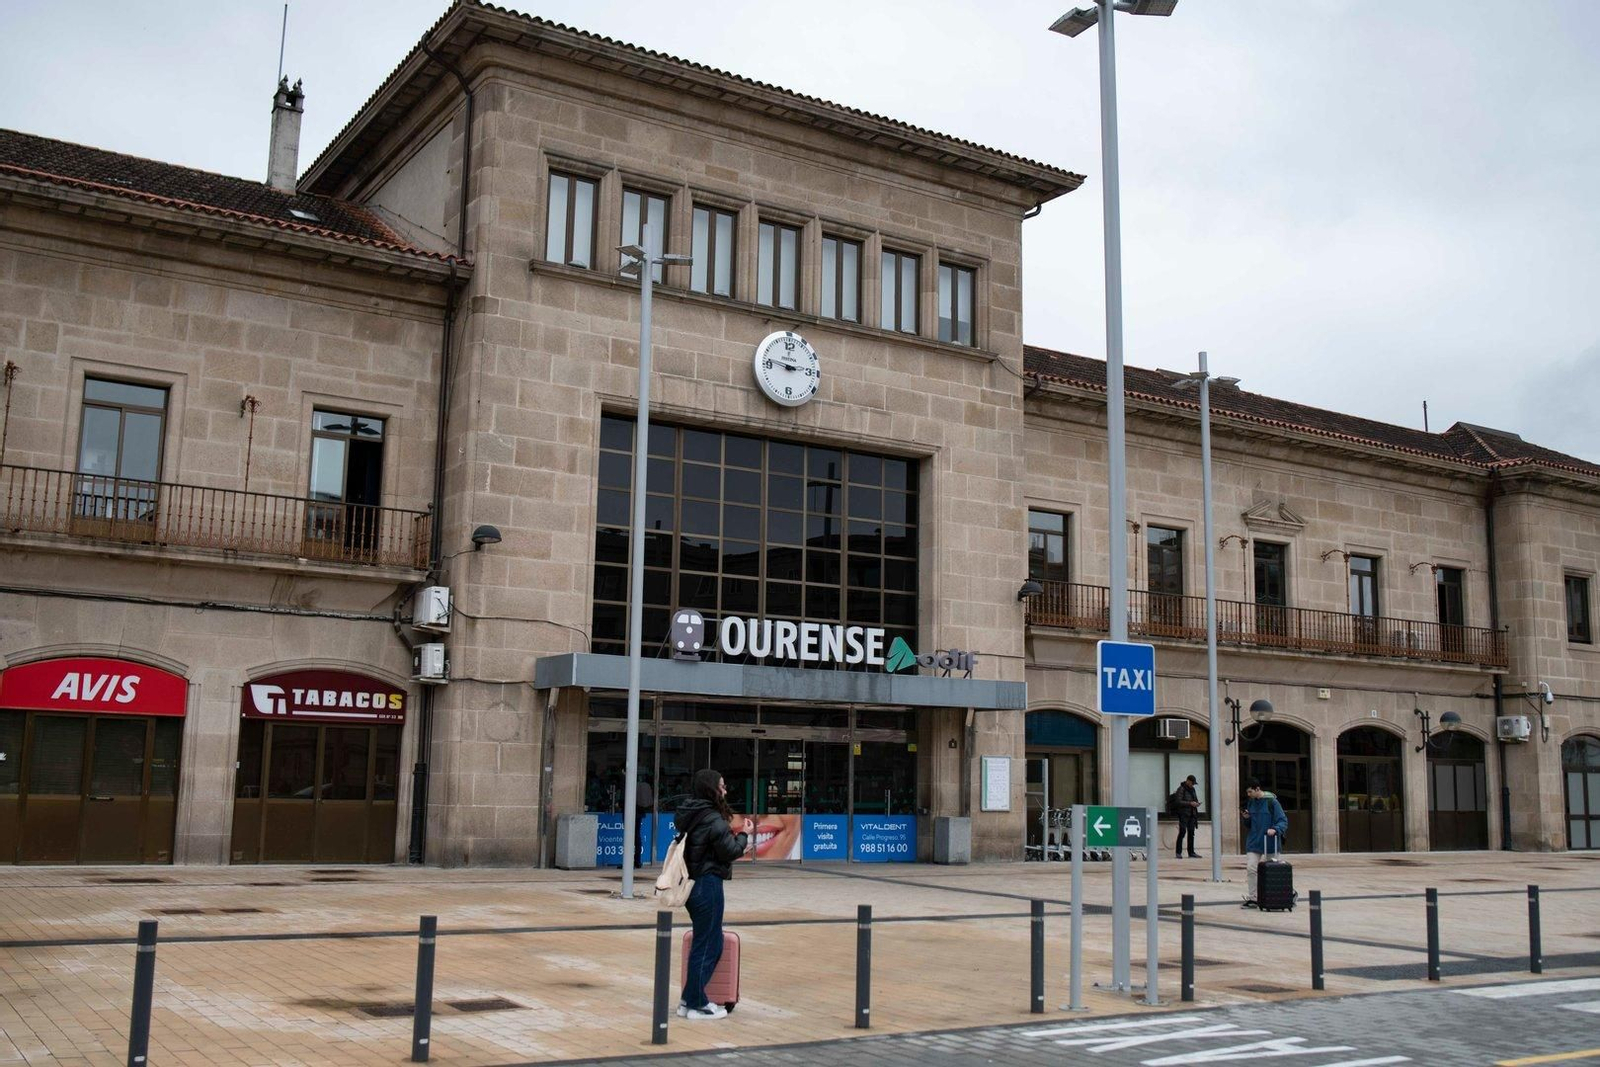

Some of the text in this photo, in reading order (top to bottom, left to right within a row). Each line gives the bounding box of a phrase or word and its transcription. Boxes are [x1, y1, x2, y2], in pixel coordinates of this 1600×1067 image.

[784, 341, 795, 351] 12
[766, 360, 773, 370] 9
[805, 367, 812, 377] 3
[785, 386, 792, 396] 6
[720, 615, 886, 665] OURENSE
[1102, 667, 1152, 691] TAXI
[51, 671, 141, 704] AVIS
[292, 688, 403, 710] TABACOS
[813, 822, 838, 830] Primera
[860, 823, 907, 831] VITALDENT
[817, 832, 834, 840] visita
[604, 846, 616, 855] 03
[813, 843, 838, 852] gratuita
[860, 843, 908, 853] 988 51 16 00
